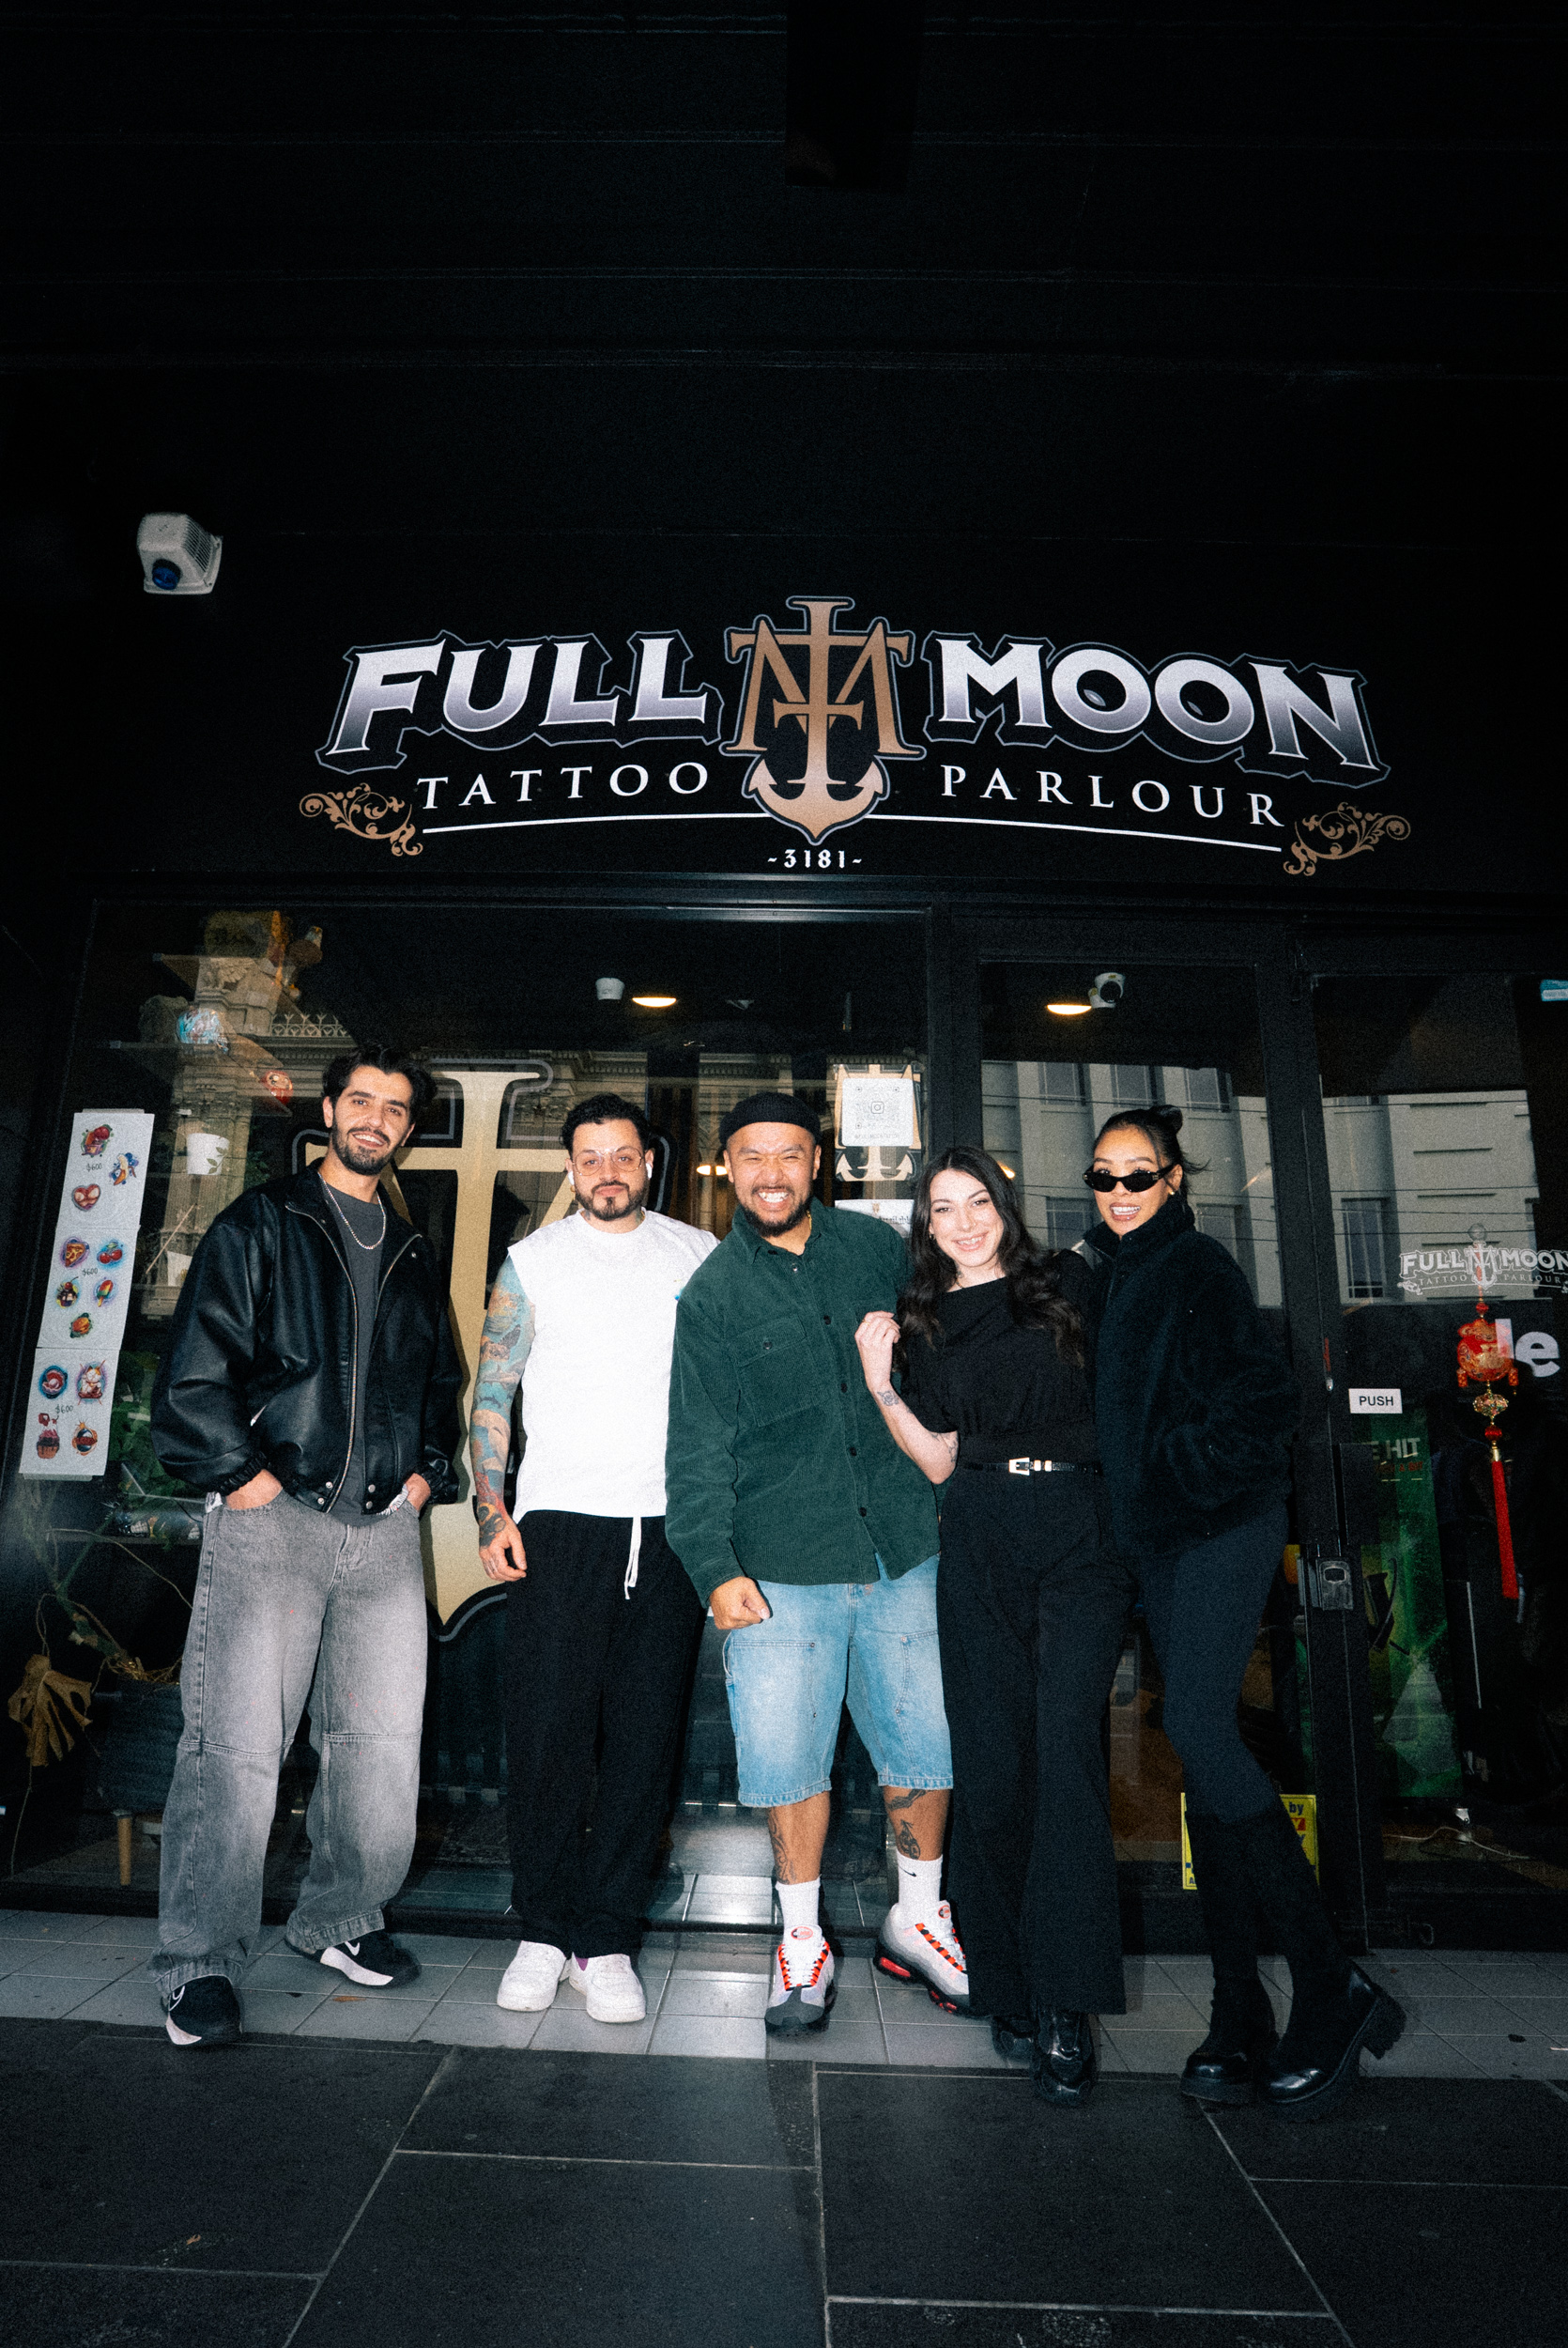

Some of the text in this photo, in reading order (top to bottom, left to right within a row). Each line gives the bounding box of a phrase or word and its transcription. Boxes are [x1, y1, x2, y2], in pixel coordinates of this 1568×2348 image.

[323, 635, 1382, 771] FULL MOON
[415, 761, 1286, 828] TATTOO PARLOUR
[85, 1162, 103, 1172] $600
[1402, 1249, 1568, 1275] FULL MOON
[81, 1267, 99, 1276] $600
[1418, 1274, 1561, 1286] TATTOO PARLOUR
[1358, 1396, 1394, 1406] PUSH
[54, 1403, 74, 1414] $600
[1385, 1437, 1421, 1460] HIT
[1288, 1801, 1304, 1815] by
